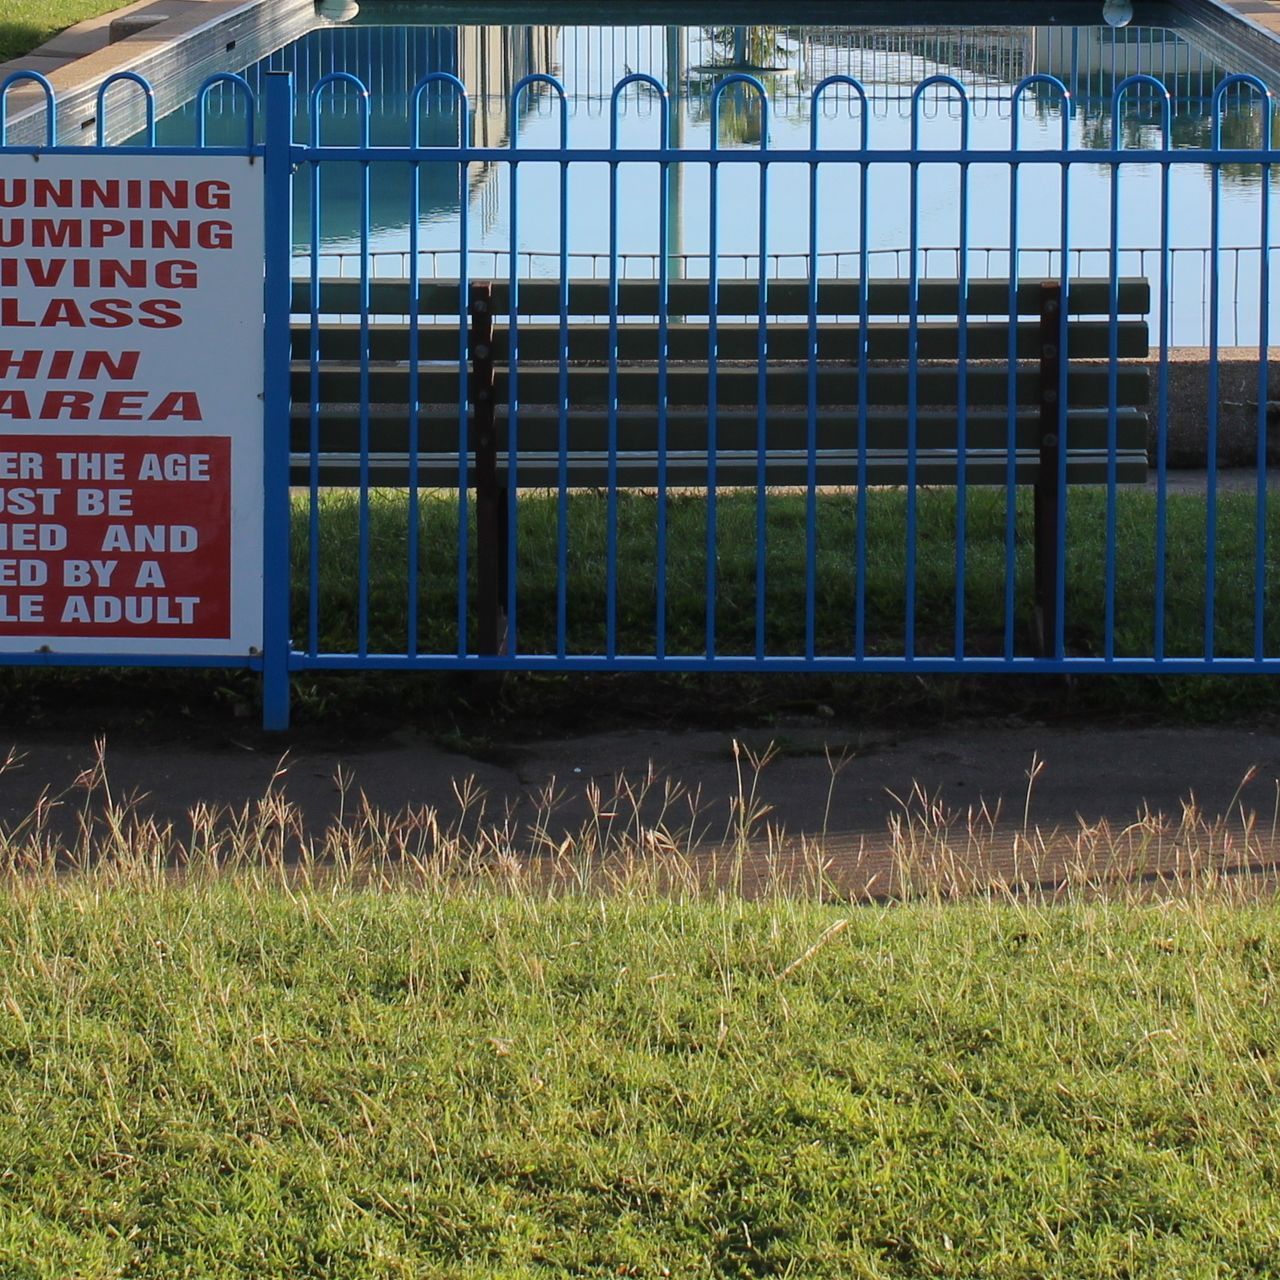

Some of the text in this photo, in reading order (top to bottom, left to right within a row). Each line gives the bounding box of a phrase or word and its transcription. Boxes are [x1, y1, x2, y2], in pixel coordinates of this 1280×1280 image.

[57, 453, 124, 481] THE
[138, 454, 210, 482] AGE
[77, 489, 133, 517] BE
[101, 524, 198, 552] AND
[63, 560, 117, 587] BY
[135, 561, 165, 588] A
[60, 596, 200, 624] ADULT
